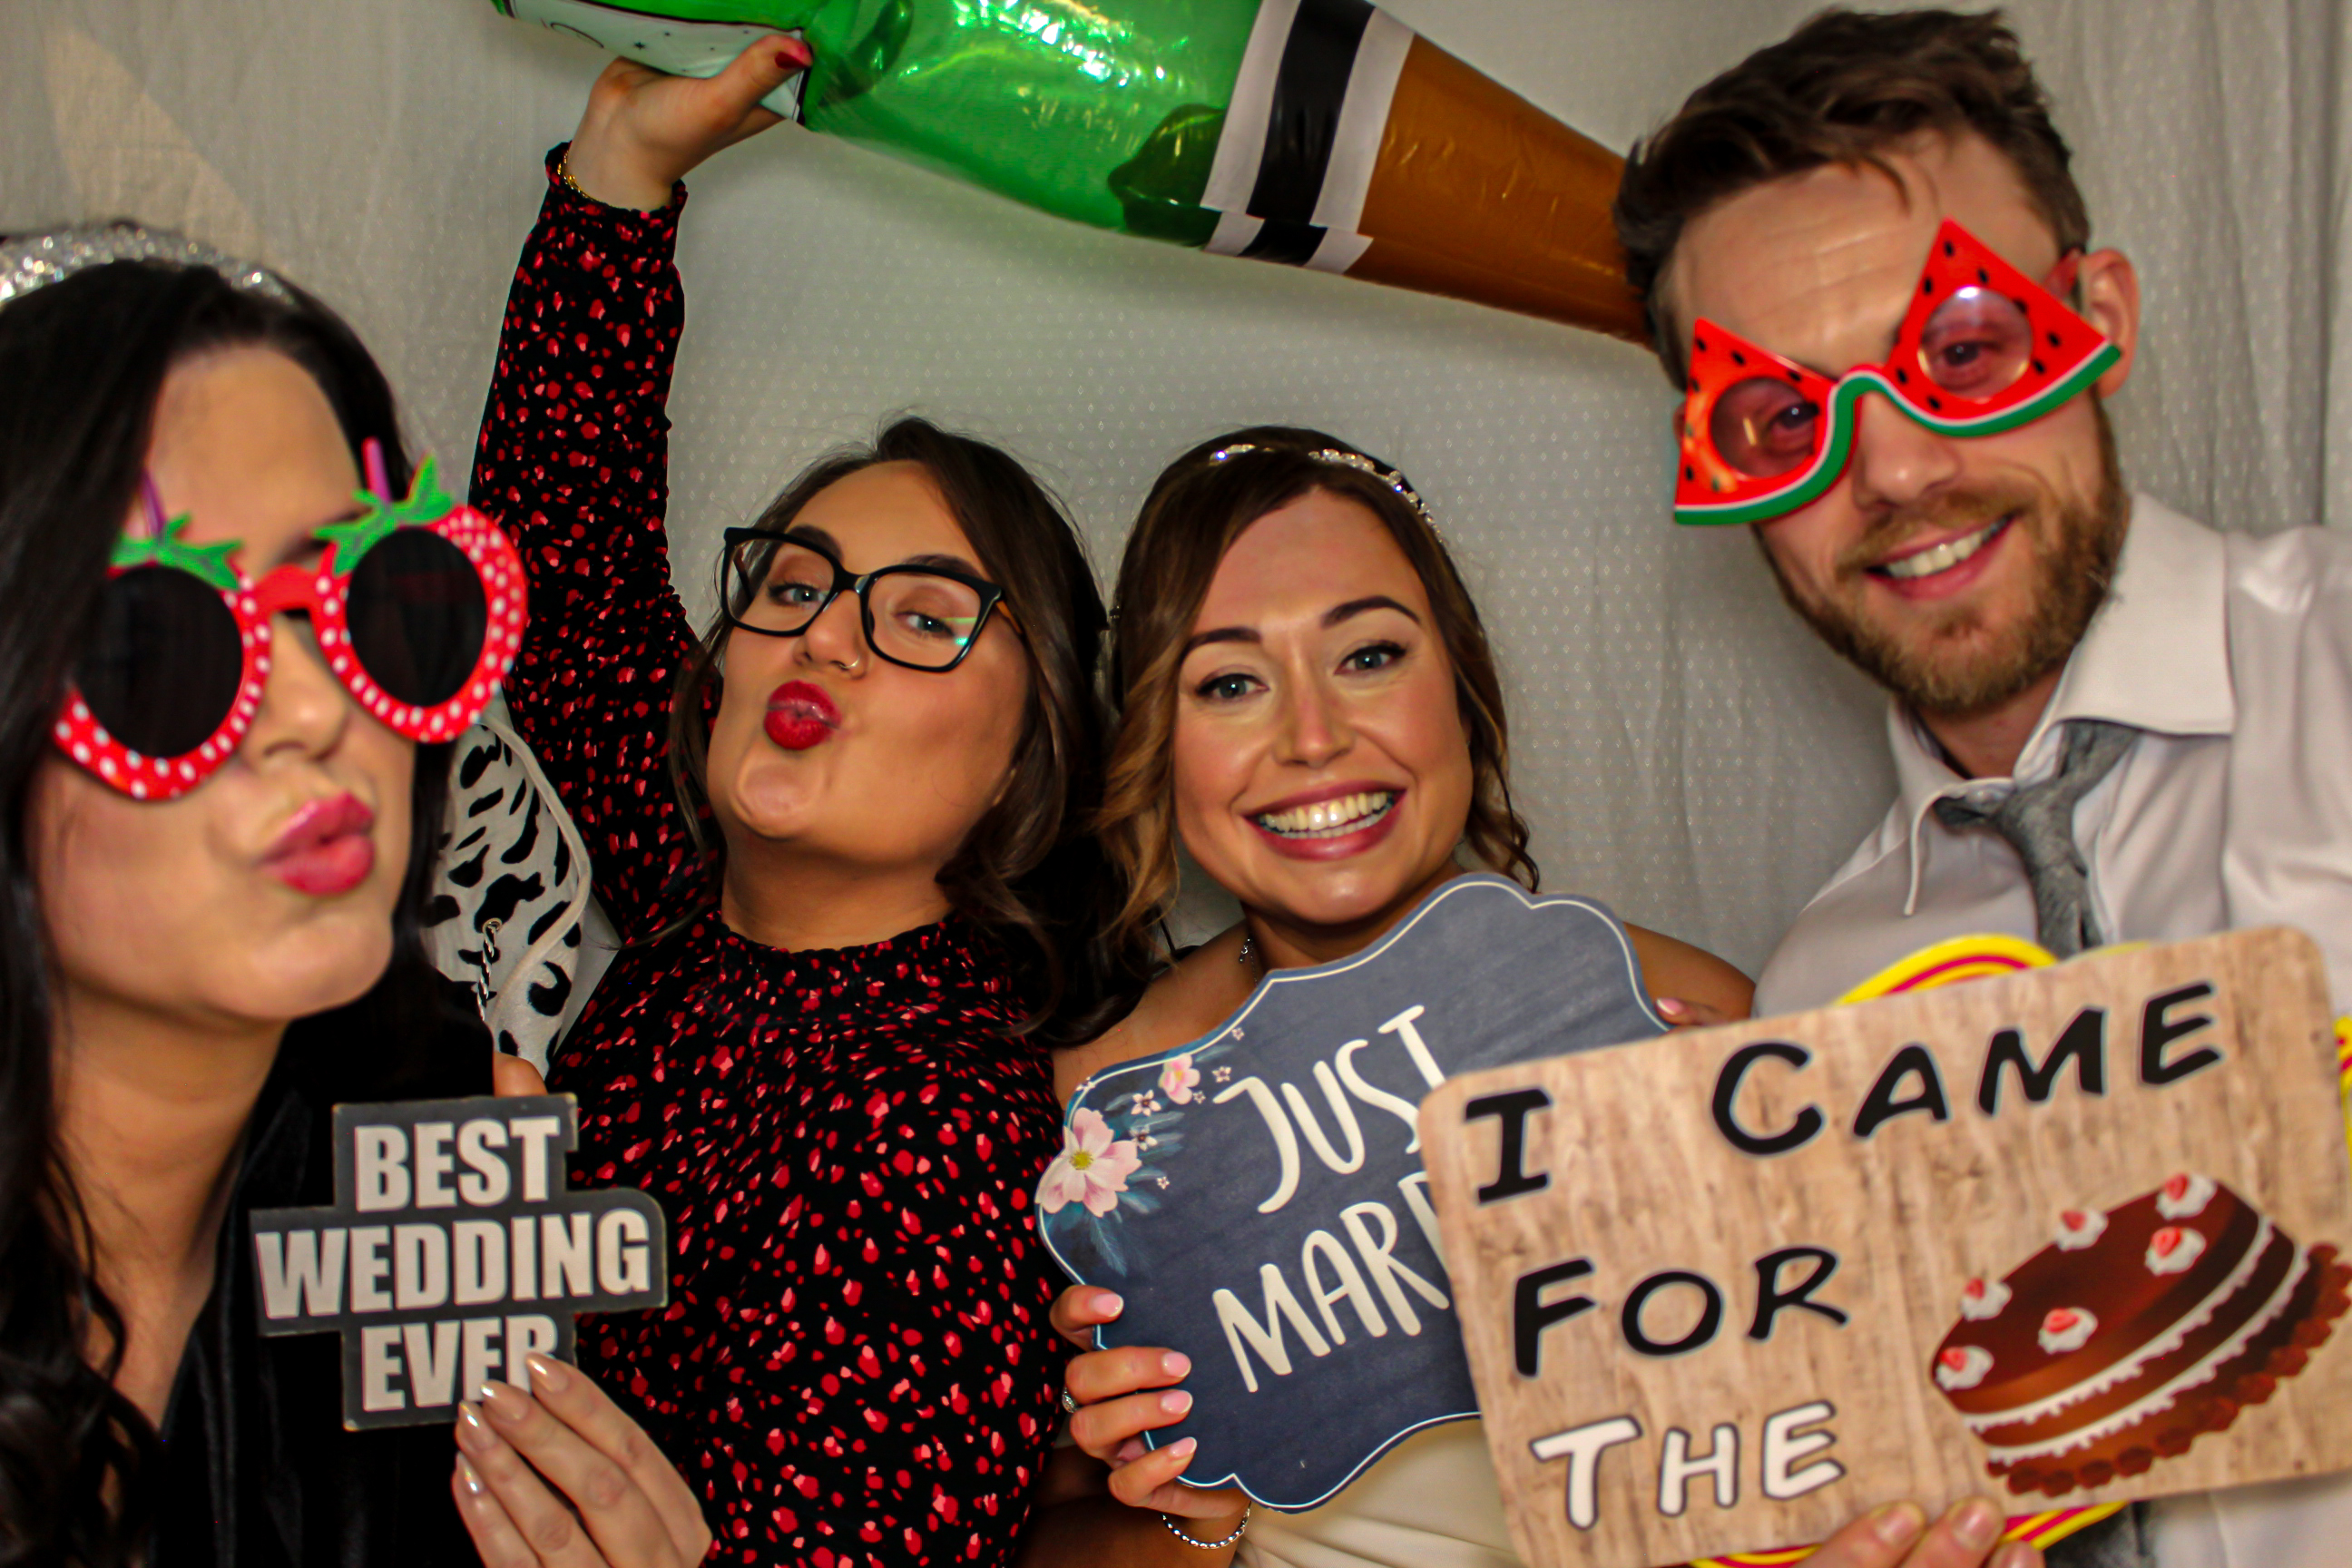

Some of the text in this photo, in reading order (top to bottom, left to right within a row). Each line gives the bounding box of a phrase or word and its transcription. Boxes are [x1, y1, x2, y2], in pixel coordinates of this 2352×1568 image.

[1212, 1004, 1446, 1214] JUST
[1464, 981, 2222, 1205] I CAME
[355, 1116, 561, 1212] BEST
[256, 1209, 651, 1319] WEDDING
[1512, 1245, 1848, 1378] FOR
[1529, 1398, 1847, 1531] THE
